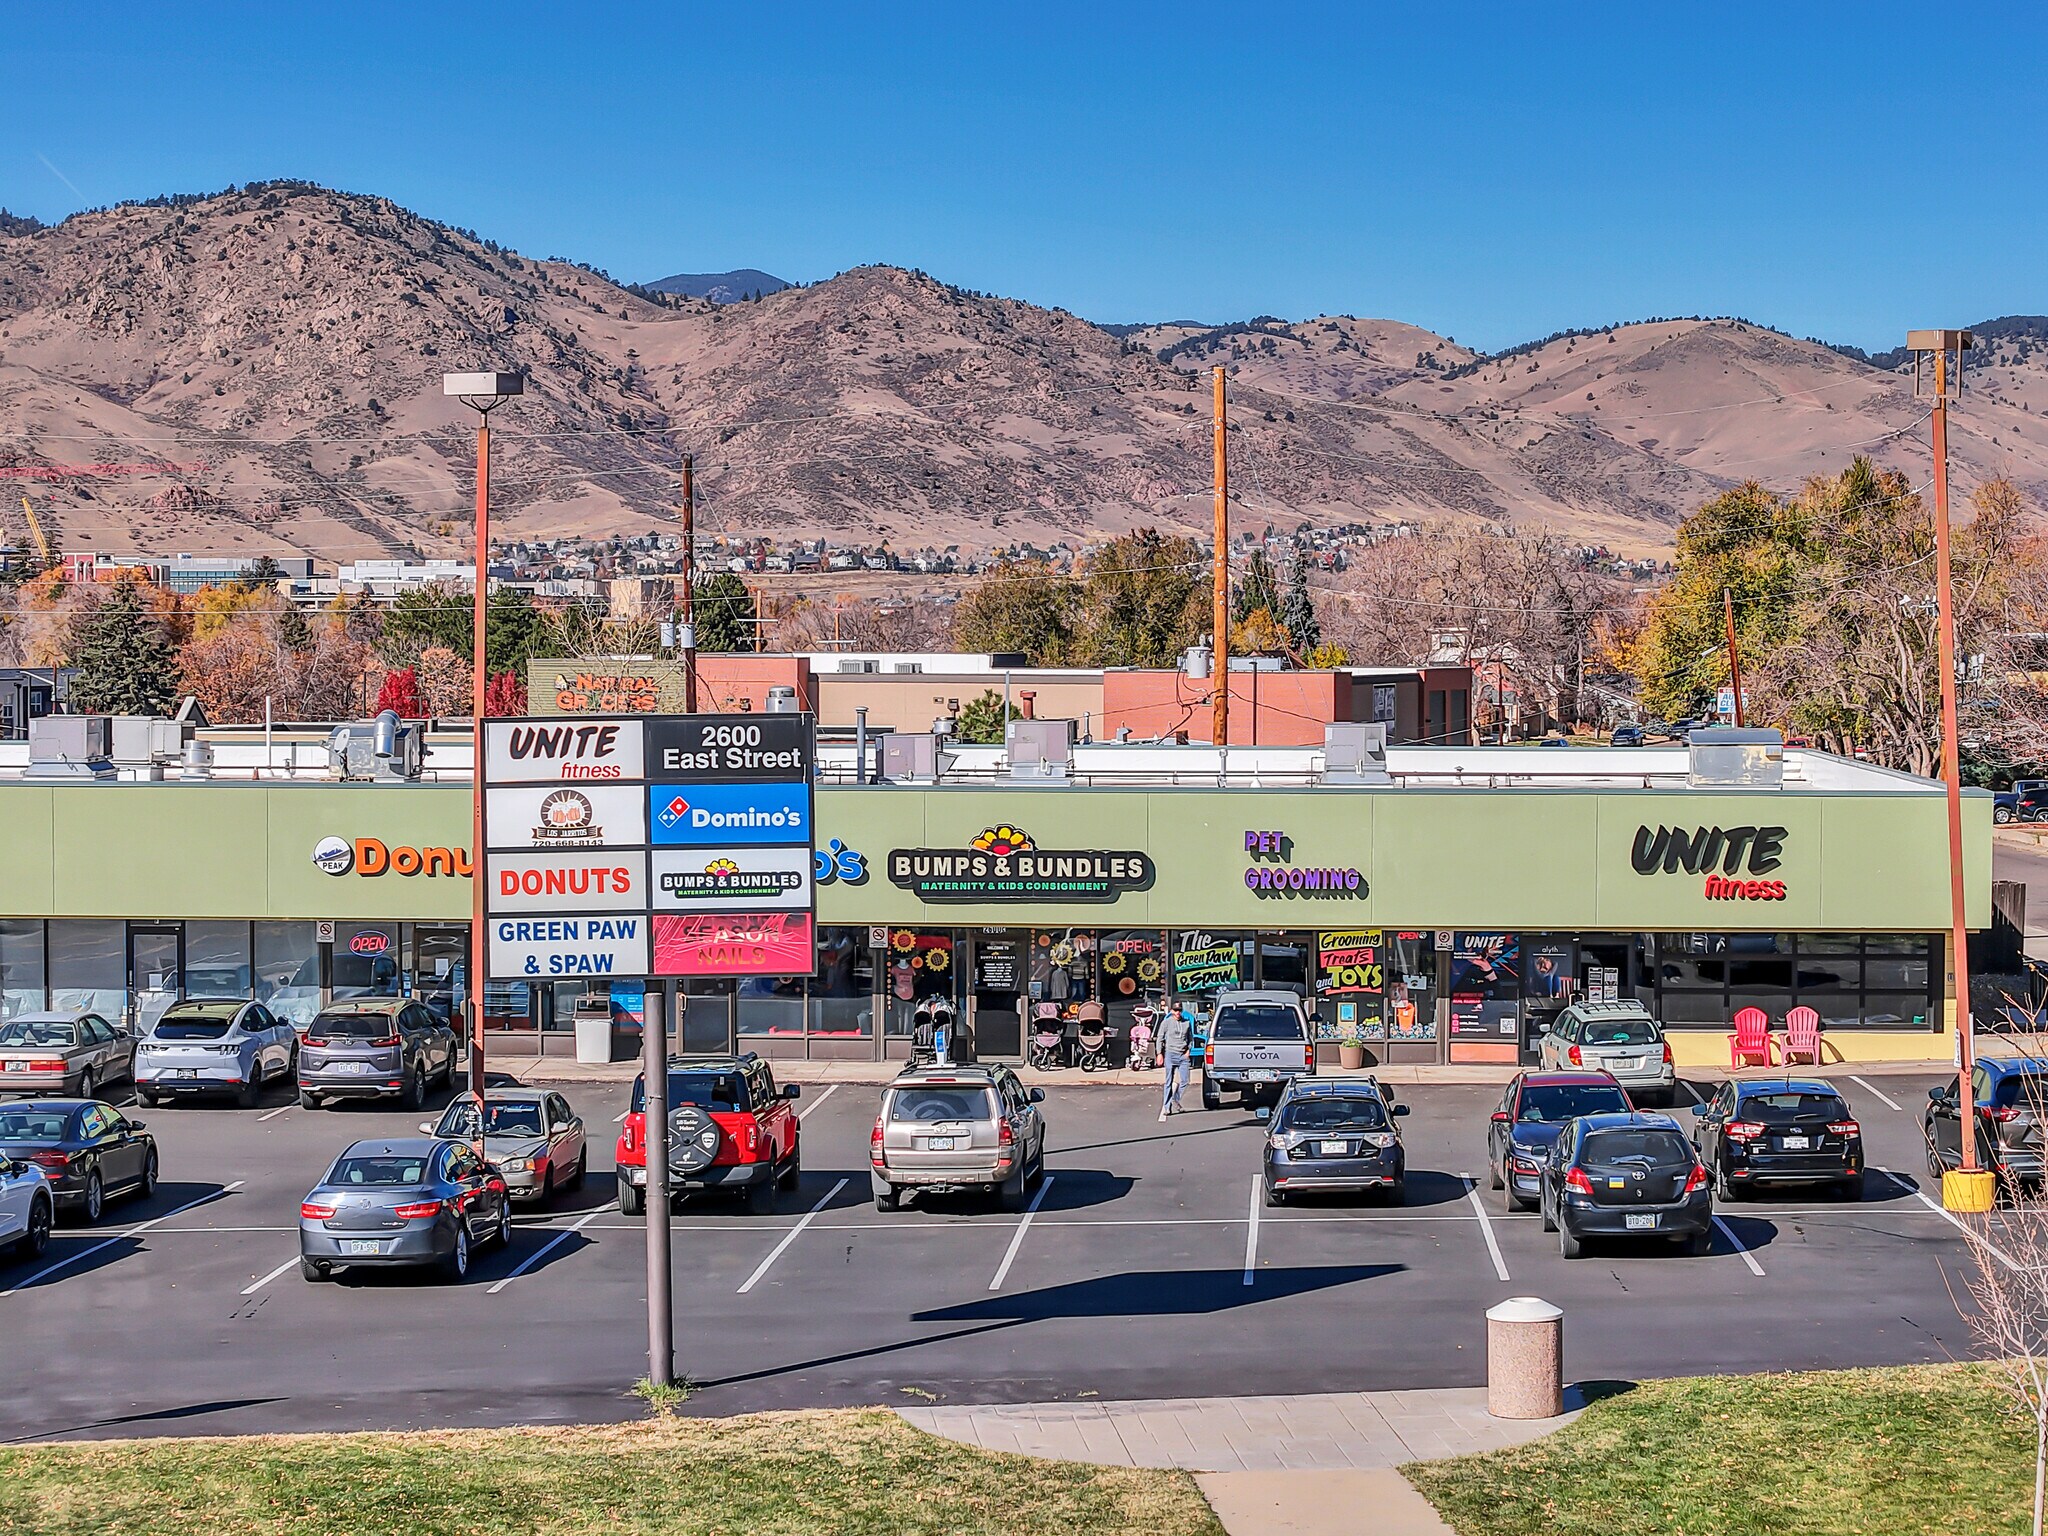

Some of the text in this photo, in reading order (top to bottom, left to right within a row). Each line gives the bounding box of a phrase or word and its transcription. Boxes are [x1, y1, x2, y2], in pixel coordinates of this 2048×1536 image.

[509, 726, 621, 760] UNITE
[701, 725, 761, 748] 2600
[663, 747, 801, 770] East Street
[561, 762, 621, 778] fitness
[692, 806, 801, 828] Domino's
[1244, 830, 1284, 853] PET
[1631, 824, 1789, 876] UNITE
[322, 862, 344, 870] PEAK
[894, 856, 1144, 878] BUMPS & BUNDLES
[499, 867, 632, 896] DONUTS
[664, 874, 800, 888] BUMPS & BUNDLES
[920, 882, 1109, 891] MATERNITY & KIDS CONSIGNMENT
[1244, 867, 1360, 890] GROOMING
[1704, 874, 1787, 900] fitness
[499, 920, 637, 942] GREEN PAW
[1179, 930, 1229, 952] The
[1320, 930, 1381, 949] Grooming
[1397, 931, 1419, 940] OPEN
[350, 935, 387, 952] OPEN
[1116, 939, 1153, 954] OPEN
[1464, 935, 1506, 949] UNITE
[523, 953, 615, 974] & SPAW
[697, 947, 768, 966] NAILS
[1176, 949, 1236, 968] Green Paw
[1323, 950, 1371, 966] Treats
[1179, 968, 1235, 991] & Spaw
[1315, 978, 1333, 989] and
[1327, 965, 1383, 989] TOYS
[1239, 1052, 1280, 1061] TOYOTA
